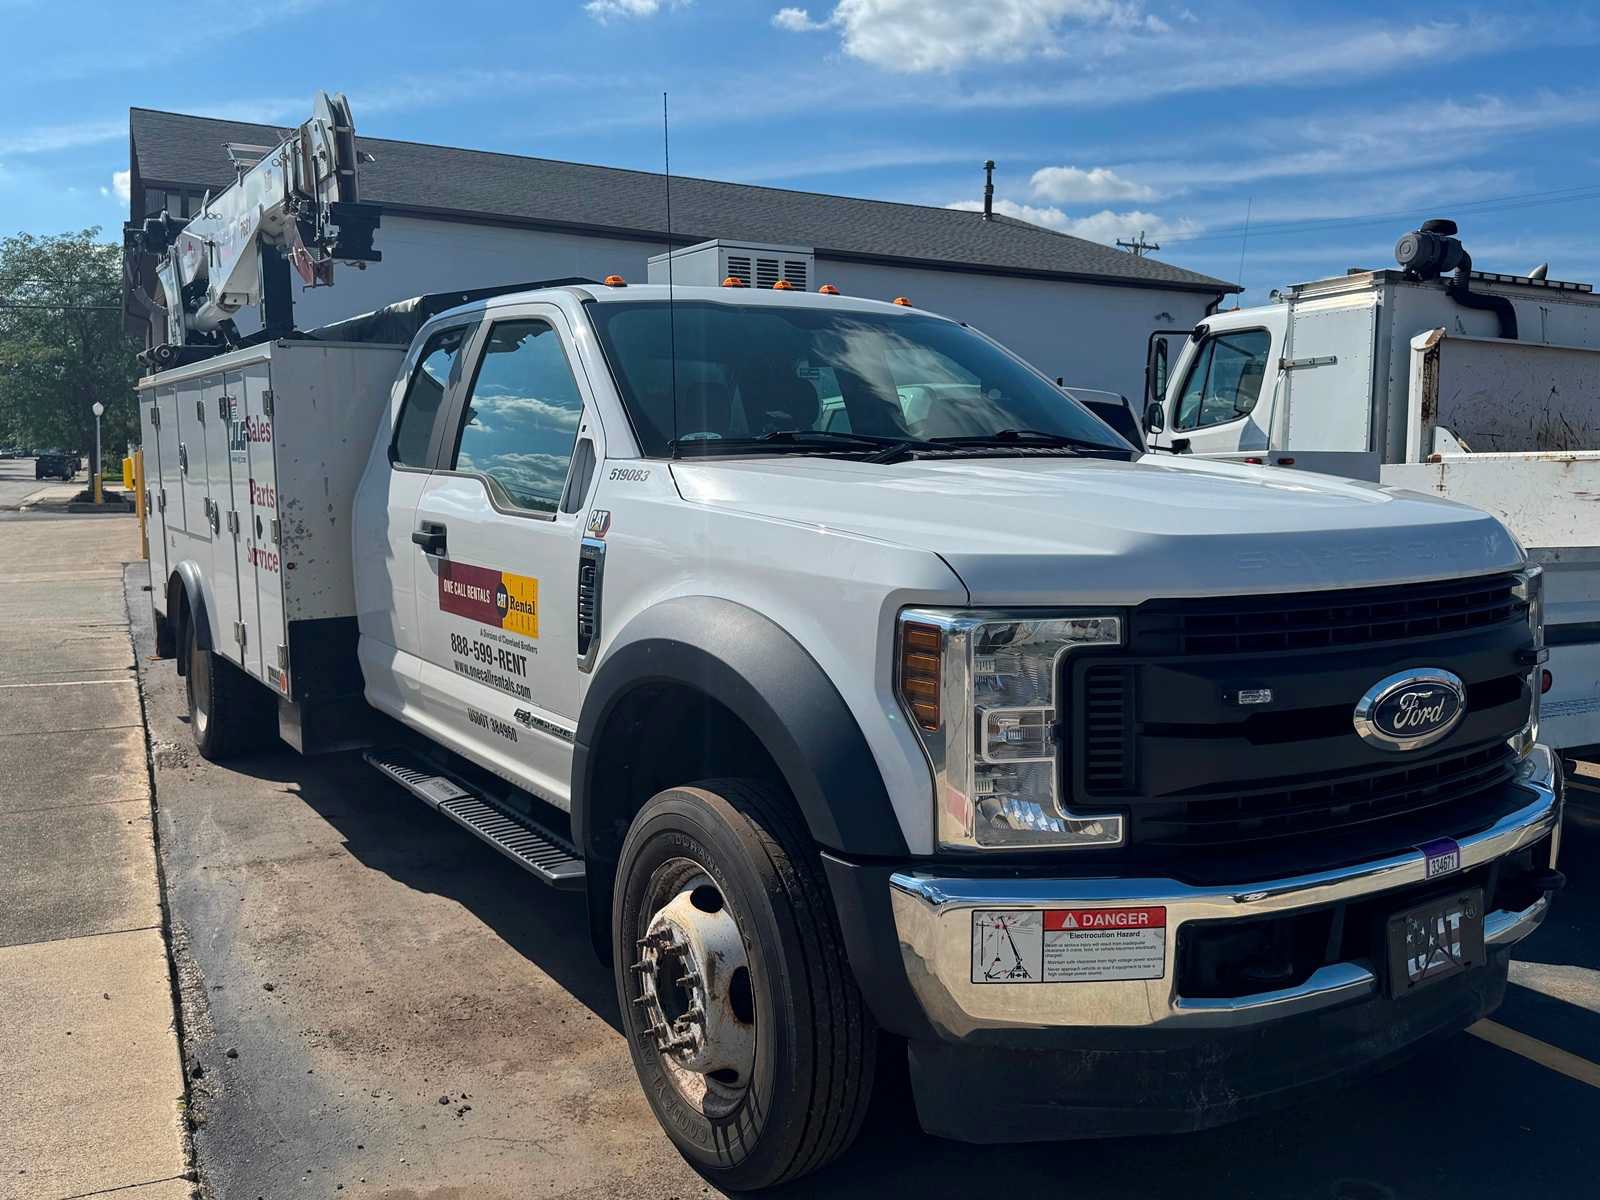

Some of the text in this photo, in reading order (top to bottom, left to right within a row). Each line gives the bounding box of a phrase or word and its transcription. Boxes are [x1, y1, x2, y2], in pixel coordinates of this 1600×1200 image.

[245, 415, 272, 442] Sales
[609, 468, 651, 482] 519083
[249, 478, 275, 508] Parts
[590, 511, 608, 531] CAT
[247, 537, 279, 573] Service
[443, 579, 491, 604] ONE CALL RENTALS
[496, 592, 507, 608] CAT
[510, 595, 536, 616] Rental
[451, 632, 527, 678] 888-599-RENT
[454, 660, 532, 700] www.onecallrentals.com
[467, 707, 490, 729] USDOT
[1393, 690, 1445, 730] Ford
[1431, 854, 1455, 874] 334671
[1082, 912, 1149, 926] DANGER
[1069, 930, 1141, 940] Electrocution Hazard
